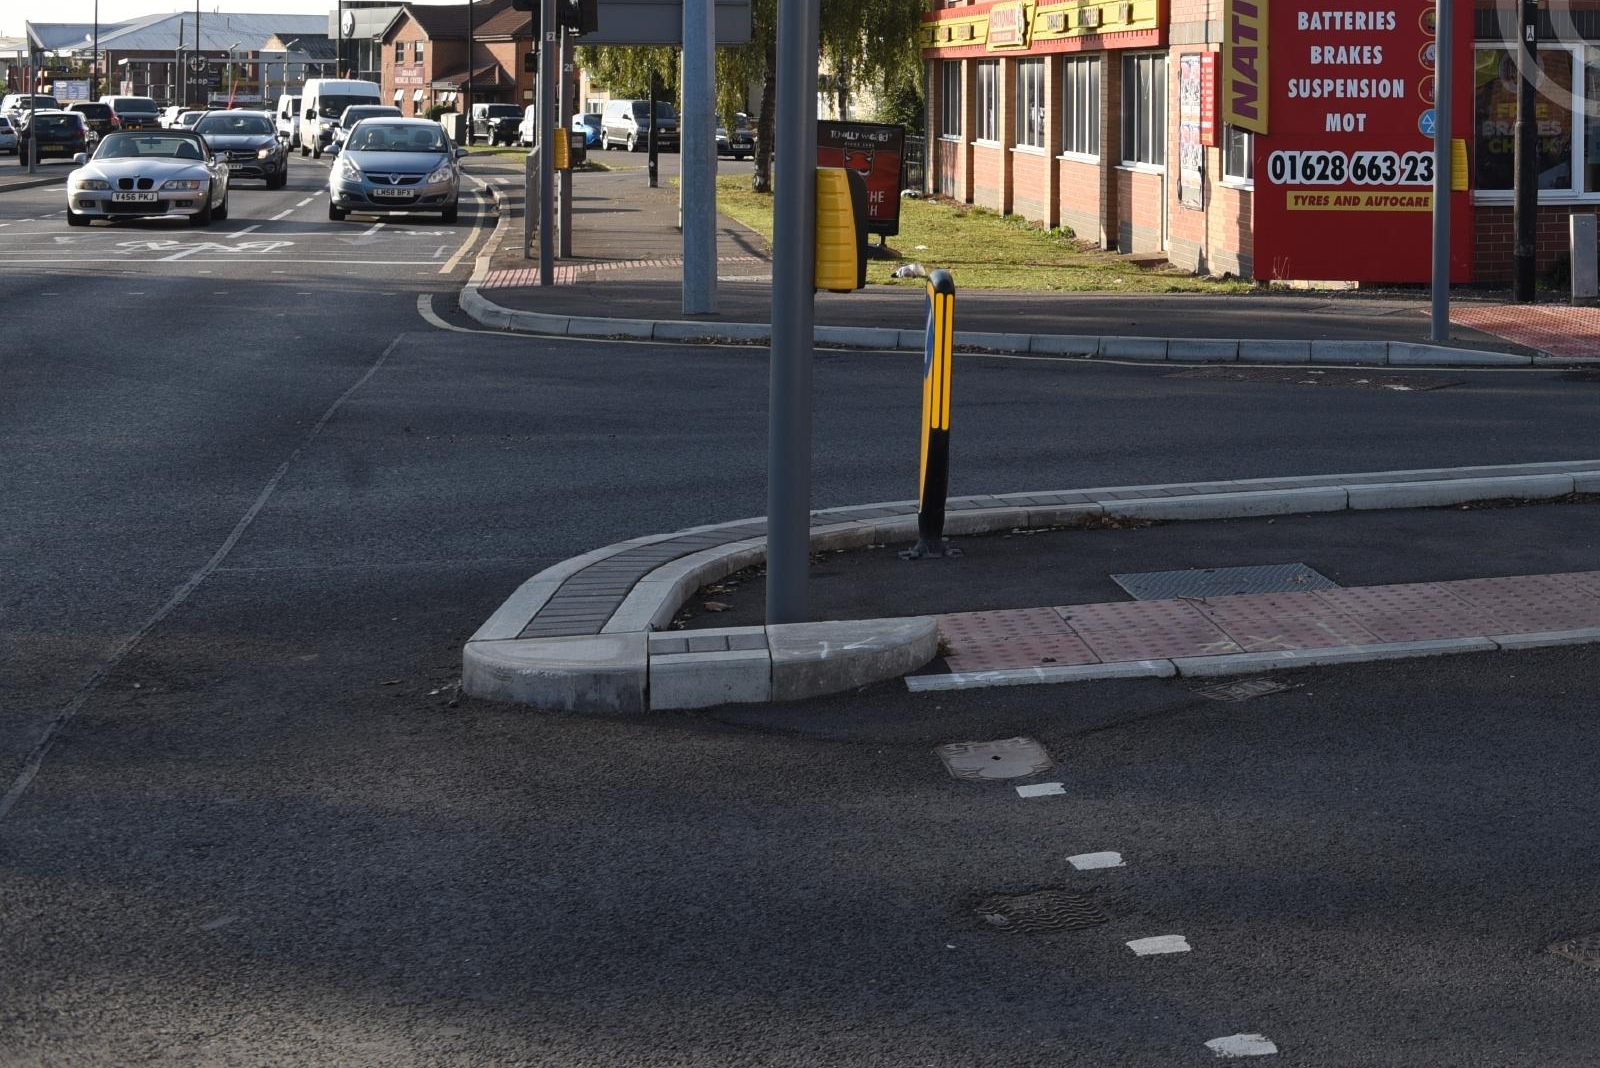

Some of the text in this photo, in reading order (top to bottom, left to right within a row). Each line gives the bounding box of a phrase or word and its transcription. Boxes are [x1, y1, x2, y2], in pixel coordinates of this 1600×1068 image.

[1297, 11, 1396, 31] BATTERIES
[1310, 46, 1383, 65] BRAKES
[1288, 79, 1404, 98] SUSPENSION
[1325, 113, 1367, 132] MOT
[1271, 155, 1346, 181] 01628
[1352, 155, 1398, 182] 663
[1293, 196, 1430, 207] TYRES AND AUTOCARE
